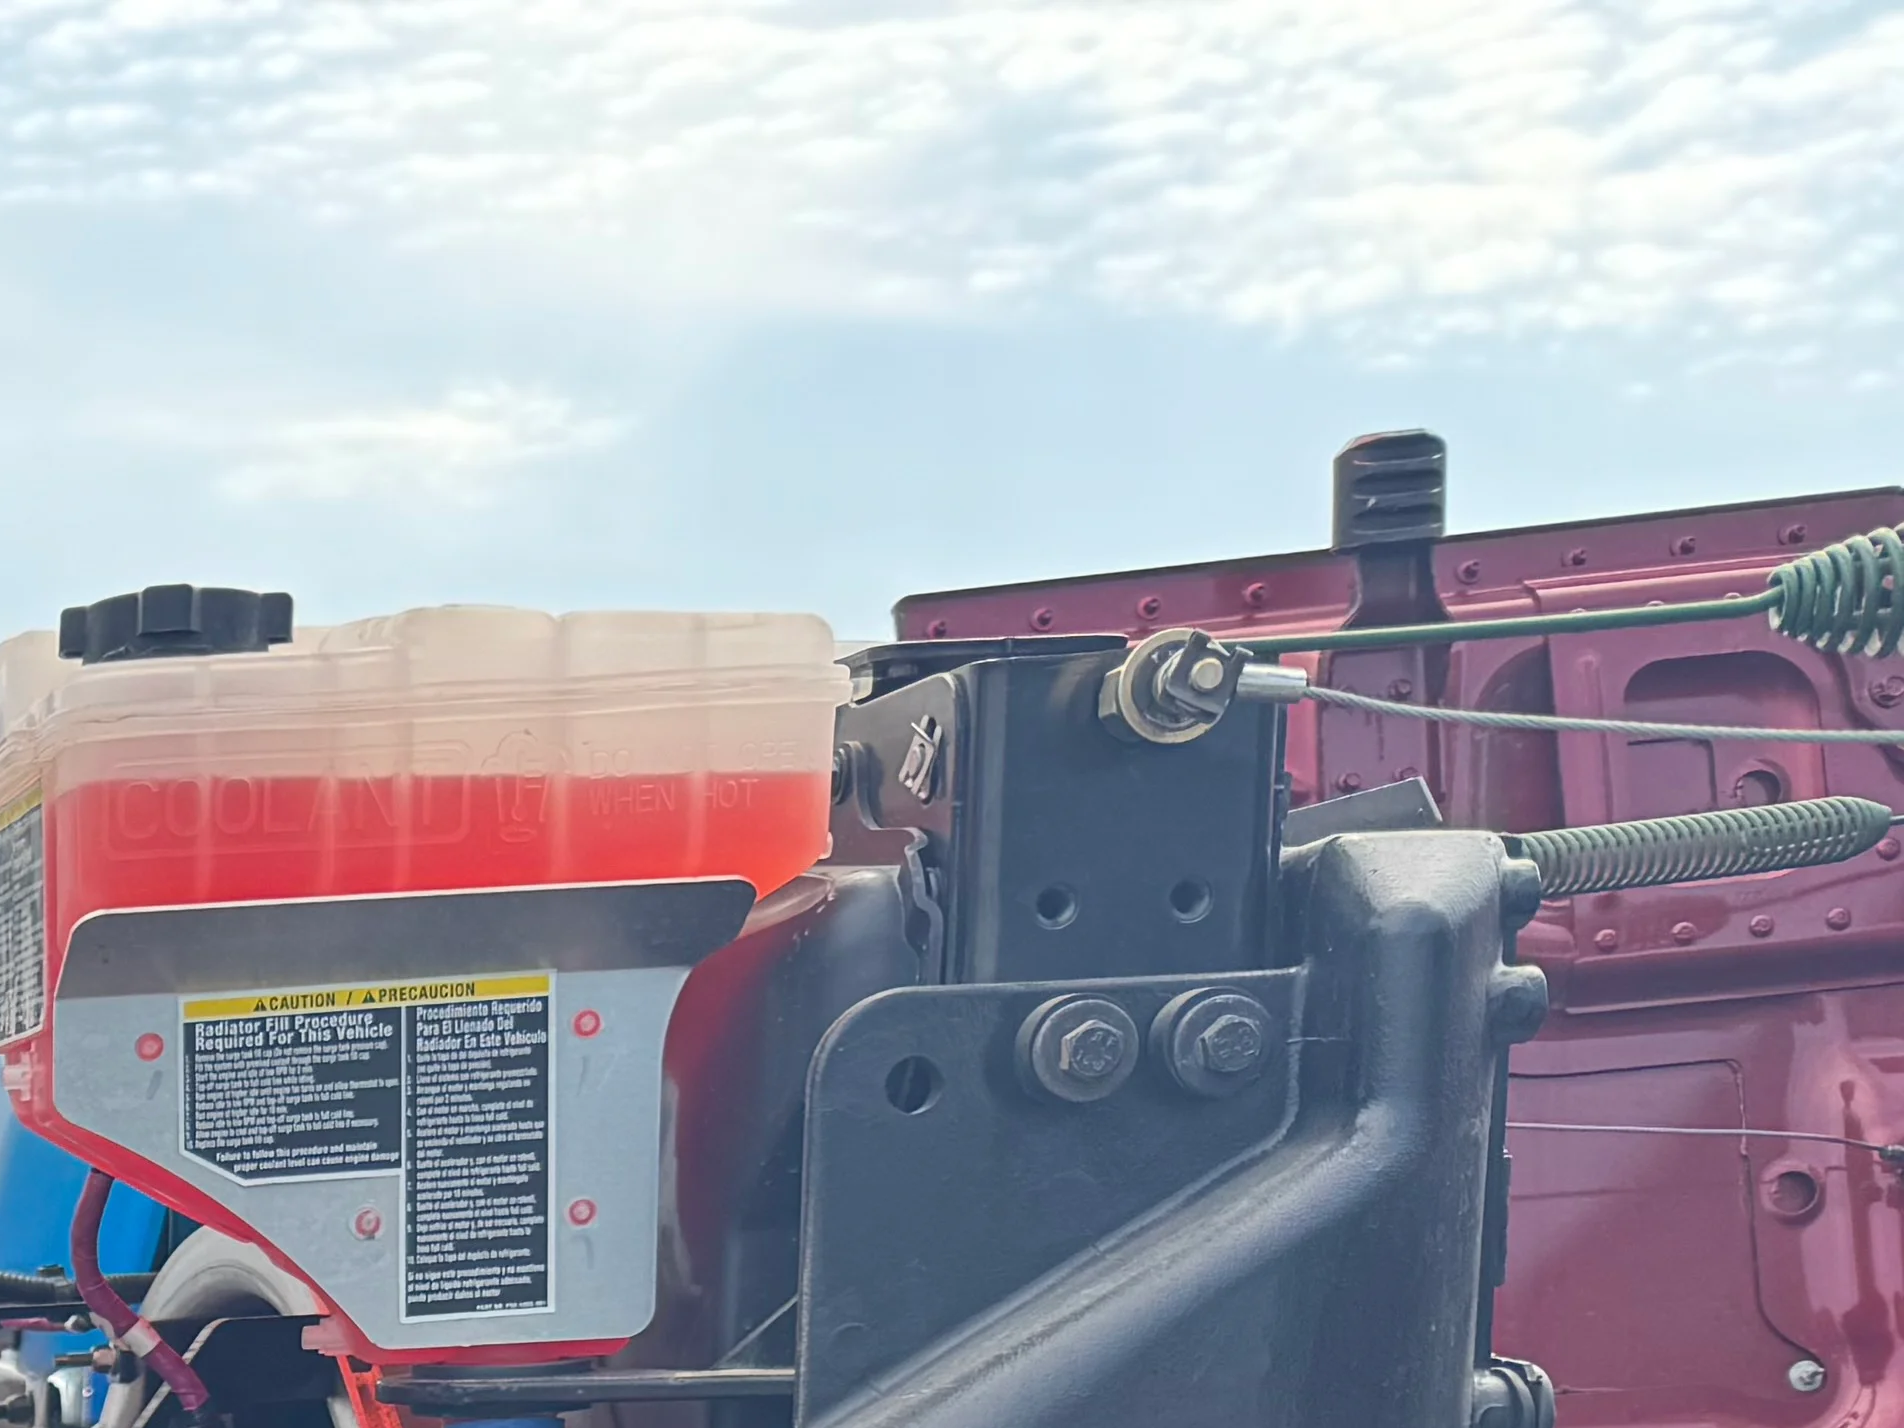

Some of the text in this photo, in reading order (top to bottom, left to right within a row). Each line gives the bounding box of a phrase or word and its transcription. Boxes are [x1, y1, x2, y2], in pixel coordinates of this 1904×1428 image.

[590, 778, 760, 815] WHEN HOT
[270, 991, 336, 1011] CAUTION
[379, 982, 475, 1002] PRECAUCION
[416, 1000, 542, 1021] Procedimiento Requerido
[195, 1011, 373, 1038] Radiator Fill Procedure
[195, 1023, 393, 1052] Required For This Vehicle
[416, 1016, 514, 1037] Para El Llenado Del
[416, 1036, 462, 1052] Radiador
[464, 1034, 476, 1049] En
[479, 1033, 501, 1048] Este
